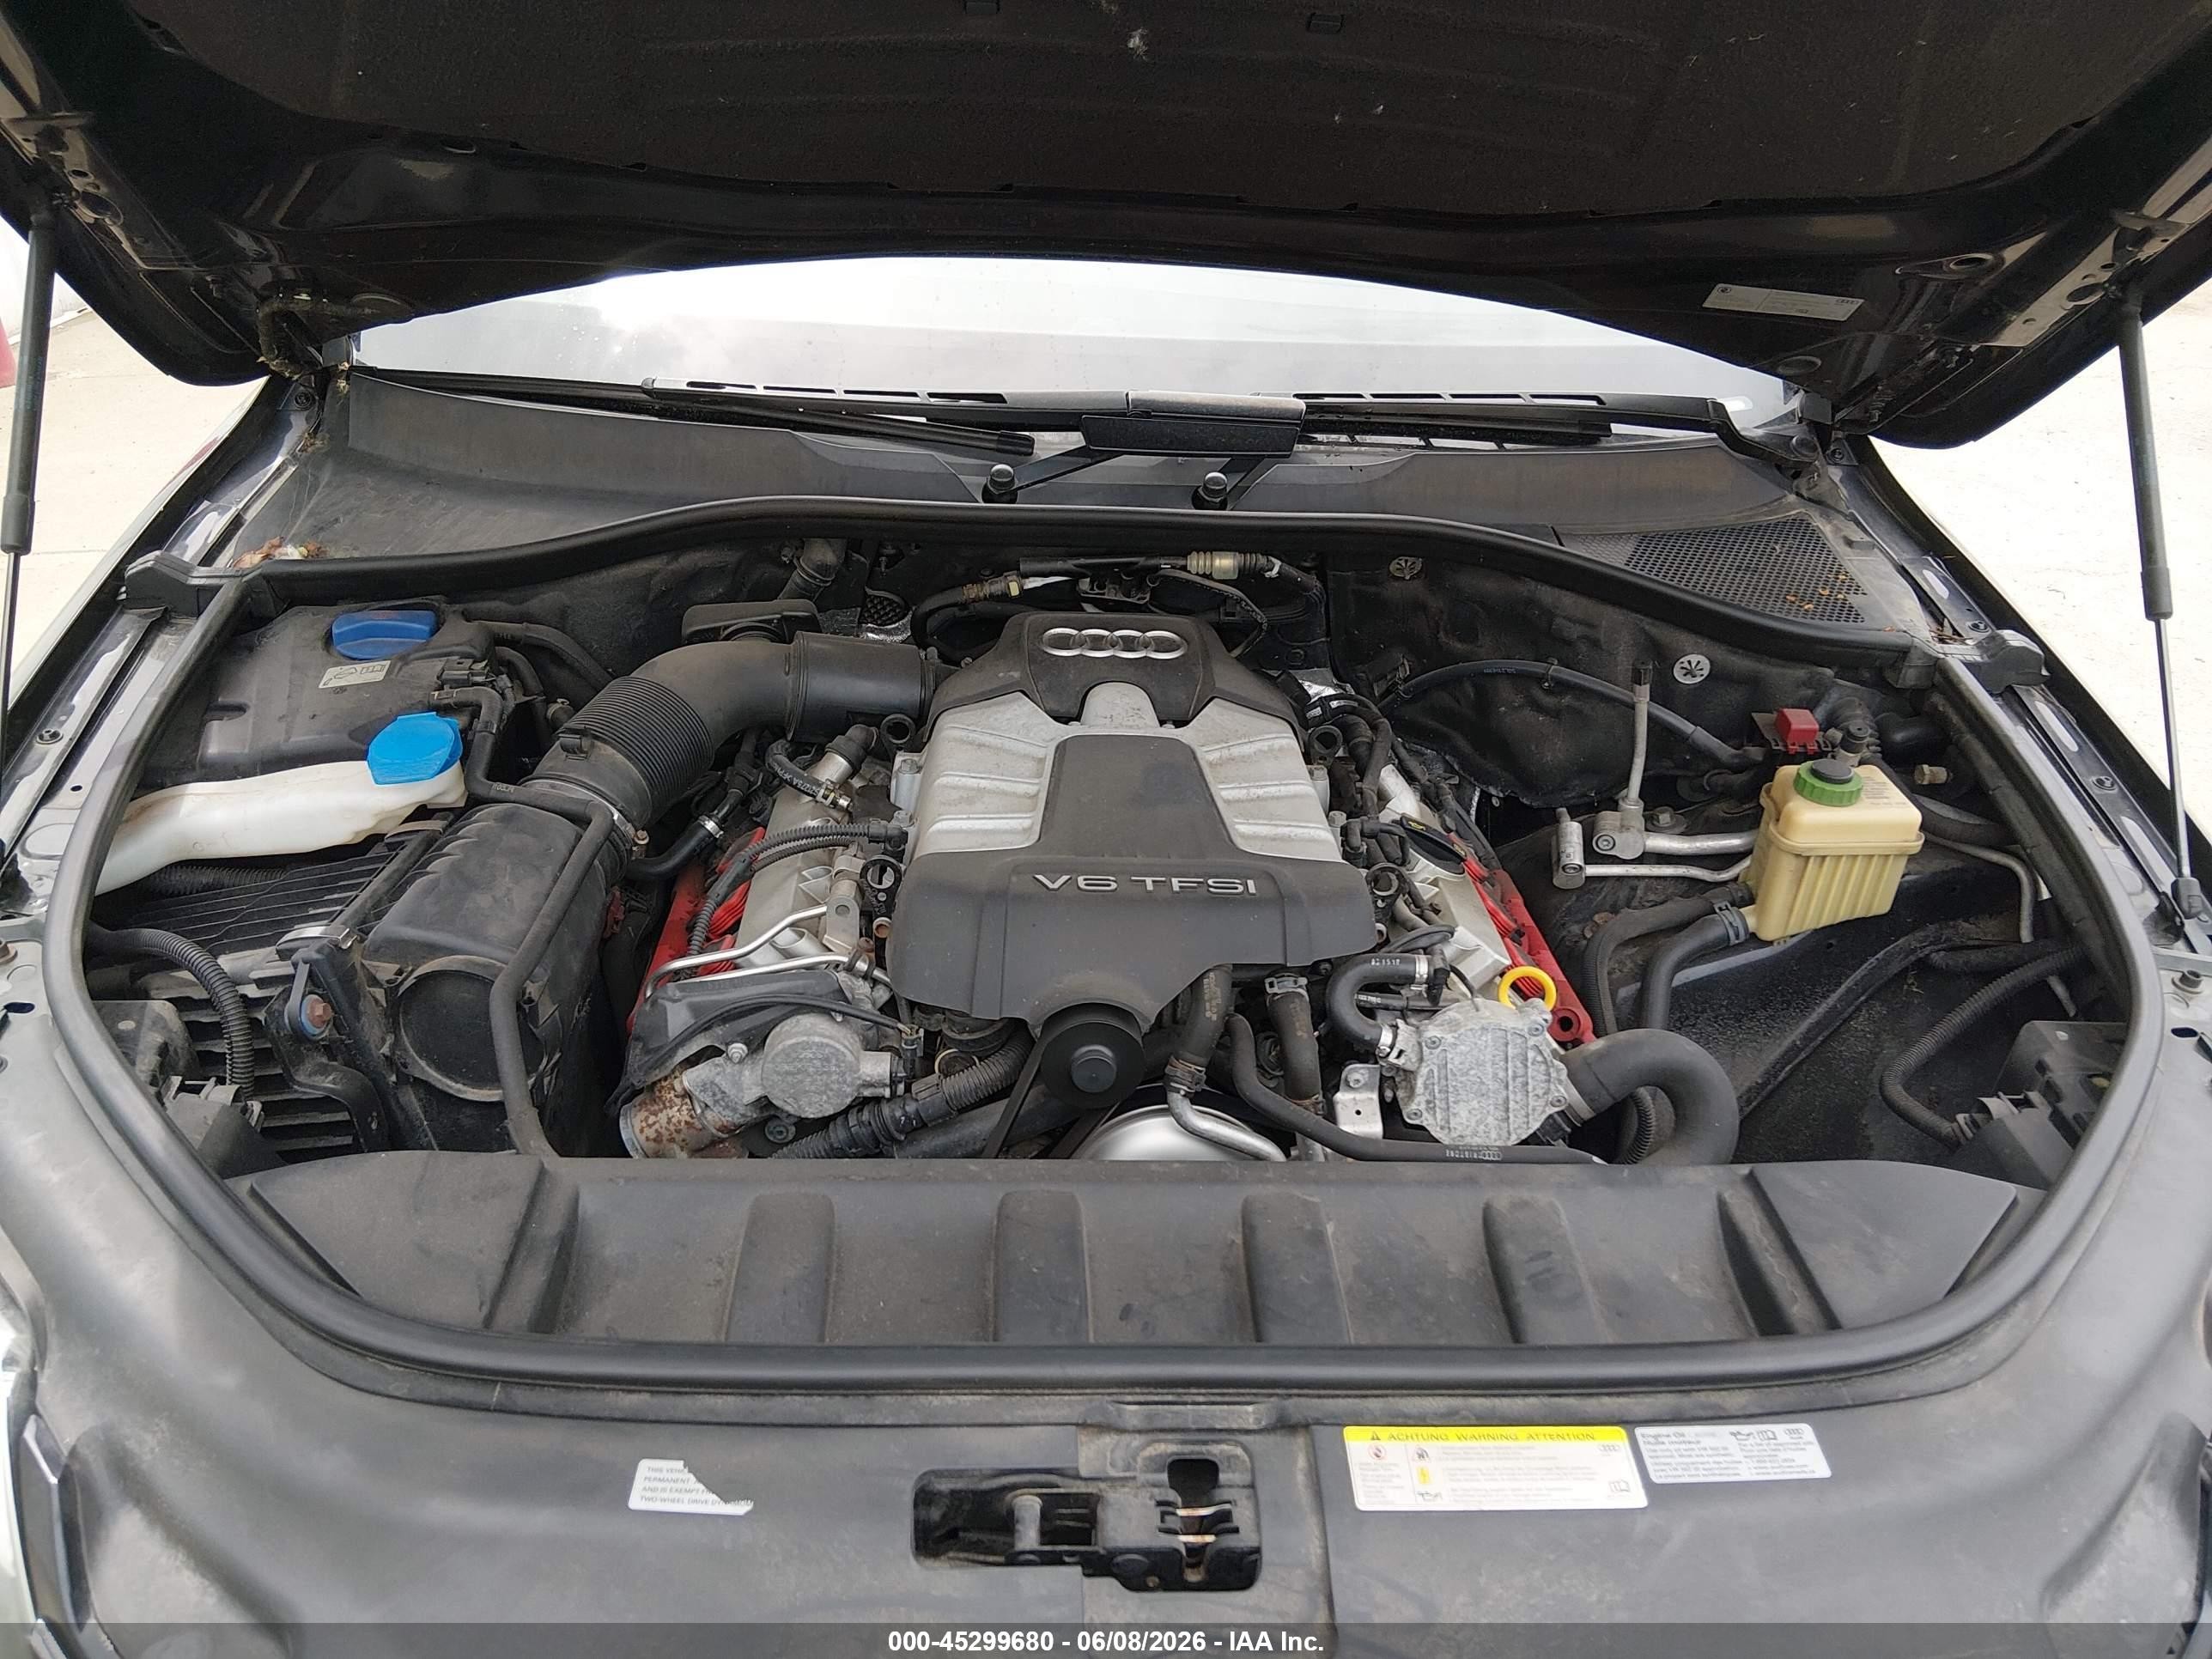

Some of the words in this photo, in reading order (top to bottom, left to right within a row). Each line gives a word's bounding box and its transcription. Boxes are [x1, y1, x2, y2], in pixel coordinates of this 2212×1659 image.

[1033, 874, 1118, 891] V6
[1130, 876, 1257, 895] TFSI
[1525, 1432, 1595, 1441] ATTENTION
